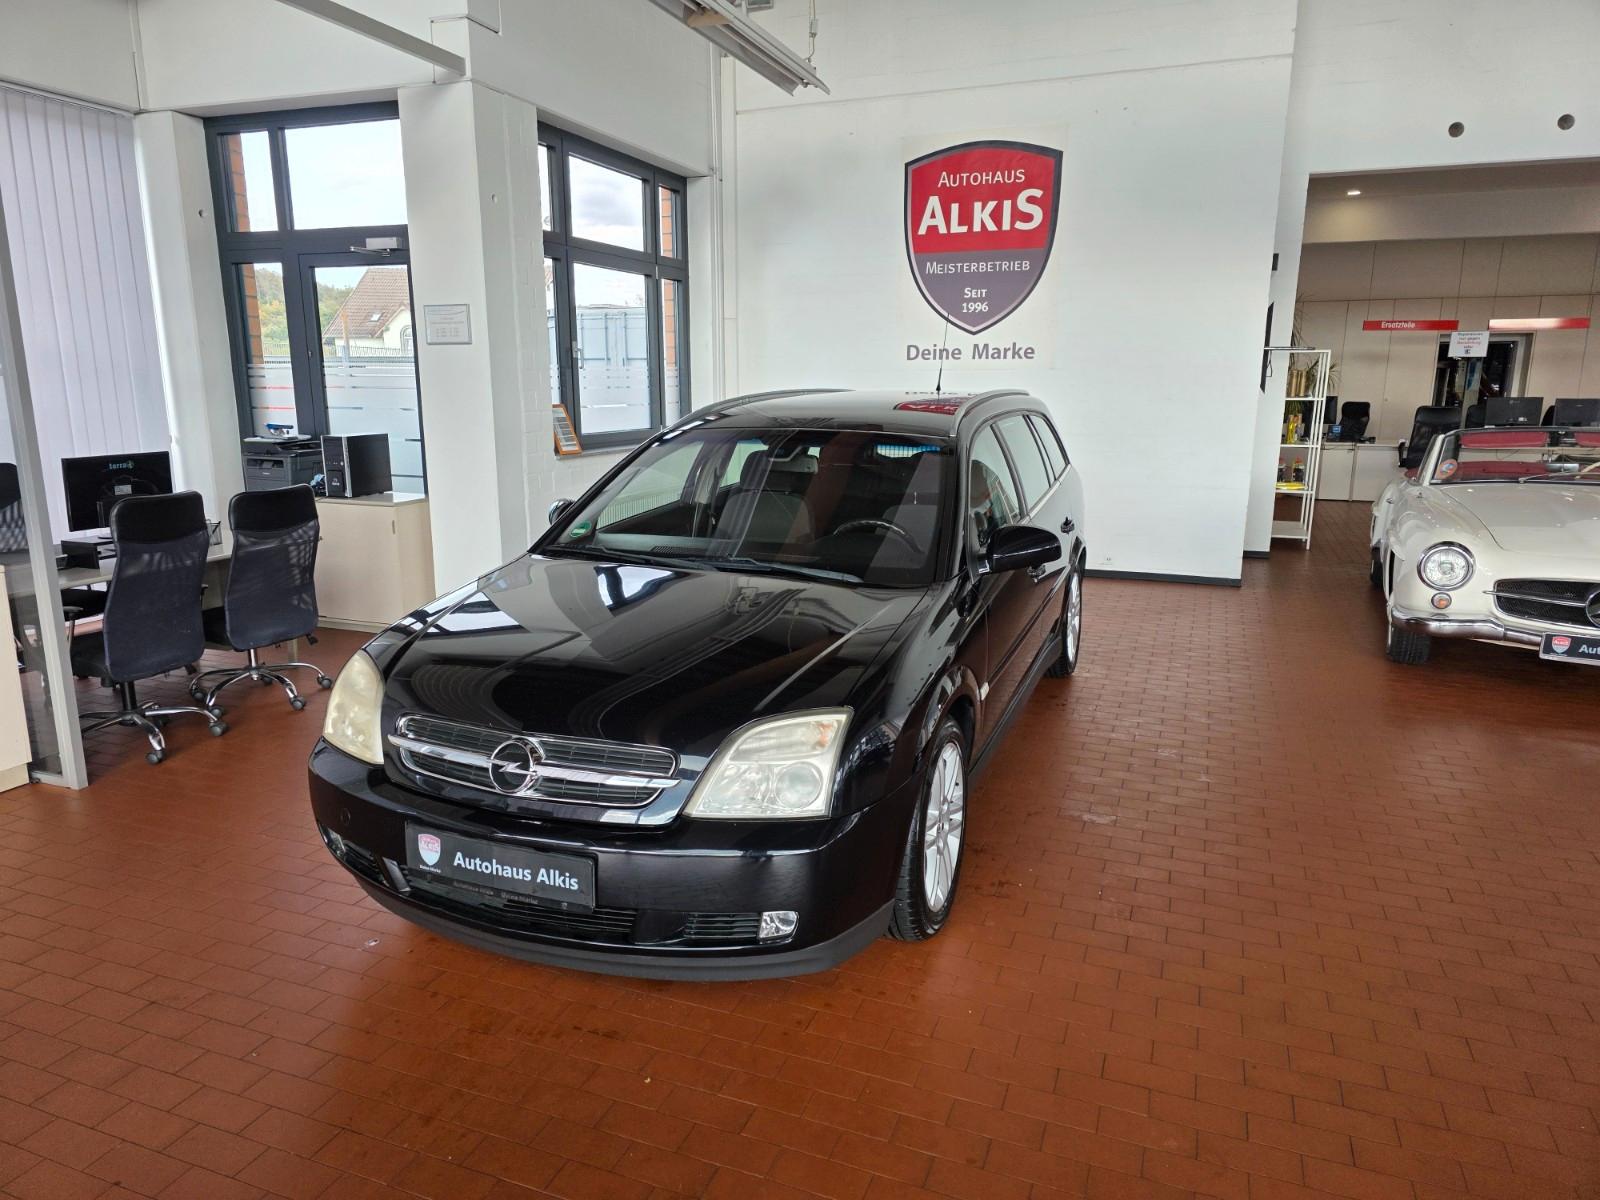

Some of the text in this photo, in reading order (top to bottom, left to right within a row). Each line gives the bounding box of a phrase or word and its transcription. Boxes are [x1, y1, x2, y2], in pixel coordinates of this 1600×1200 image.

[937, 169, 1025, 188] AUTOHAUS
[917, 188, 1044, 235] ALKIS
[926, 260, 1030, 275] MEISTERBETRIEB
[964, 287, 987, 298] SEIT
[962, 302, 989, 313] 1996
[906, 342, 1035, 361] Deine Marke
[453, 851, 579, 891] Autohaus Alkis
